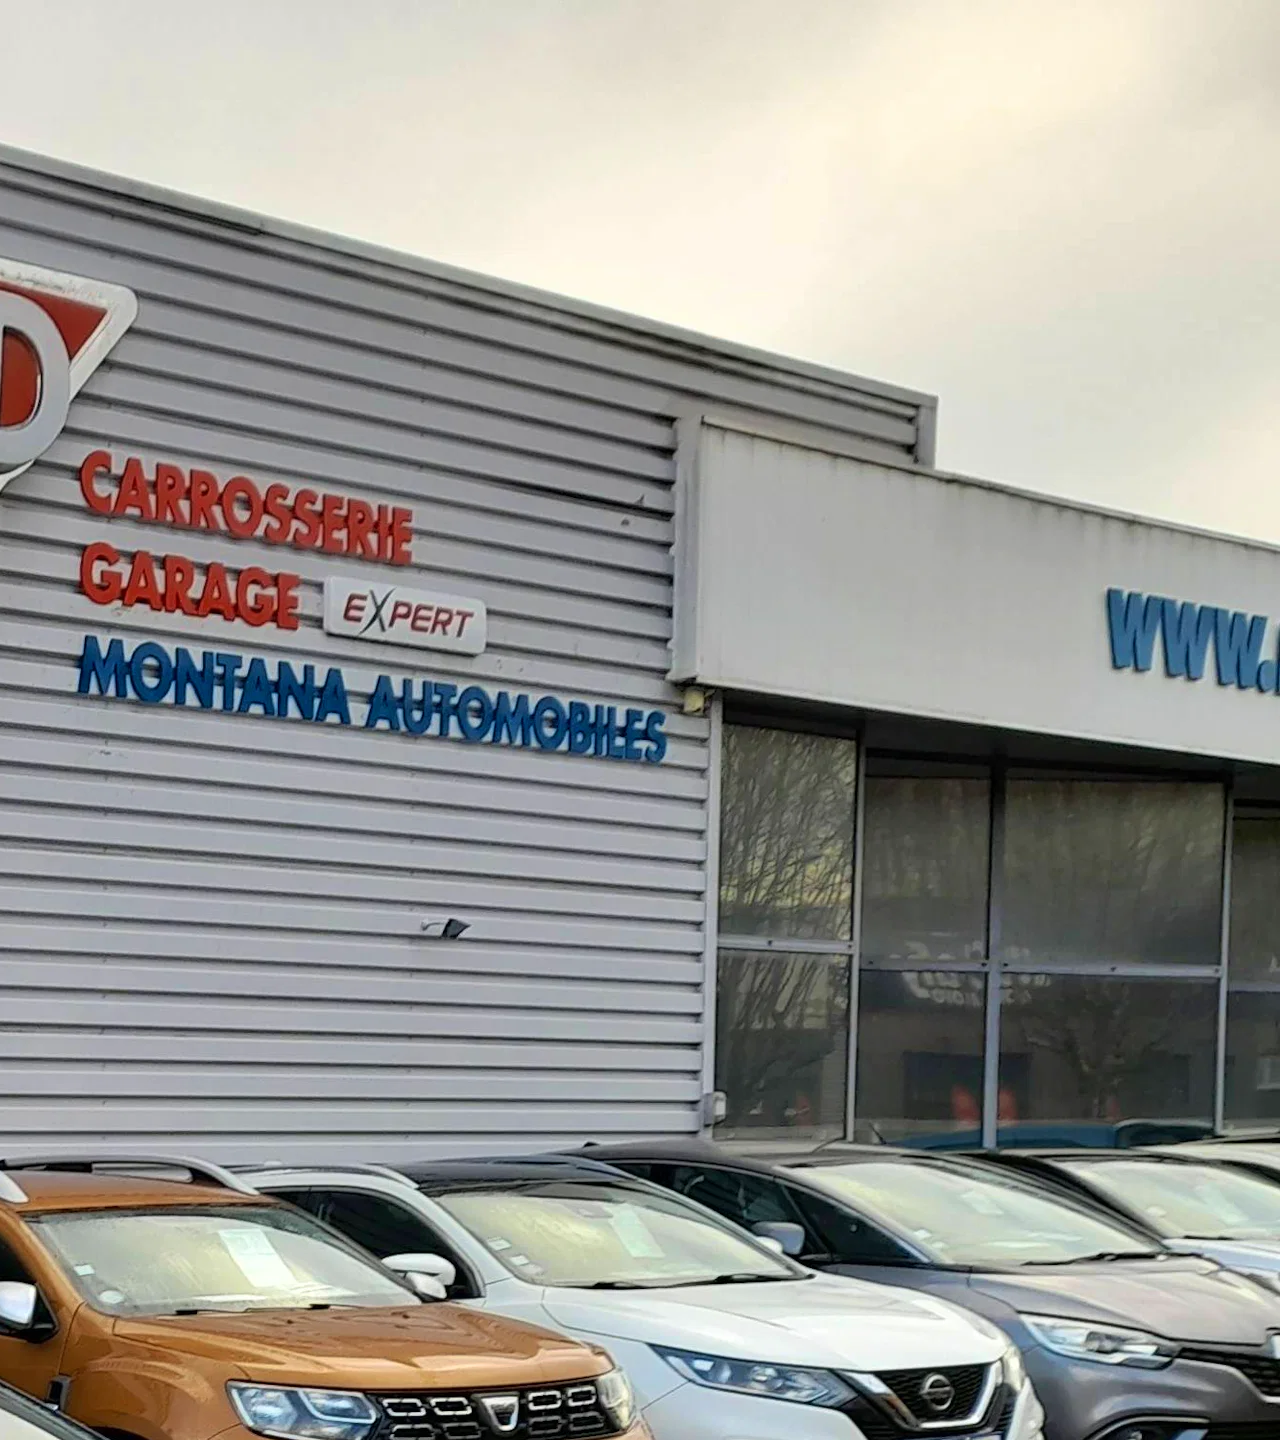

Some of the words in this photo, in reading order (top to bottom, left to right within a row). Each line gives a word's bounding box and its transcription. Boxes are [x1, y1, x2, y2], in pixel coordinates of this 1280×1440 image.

[79, 450, 413, 566] CARROSSERIE
[80, 541, 300, 630] GARAGE
[343, 587, 474, 638] EXPERT
[1106, 587, 1280, 696] WWW.
[77, 635, 351, 725] MONTANA
[365, 675, 667, 764] AUTOMOBILES
